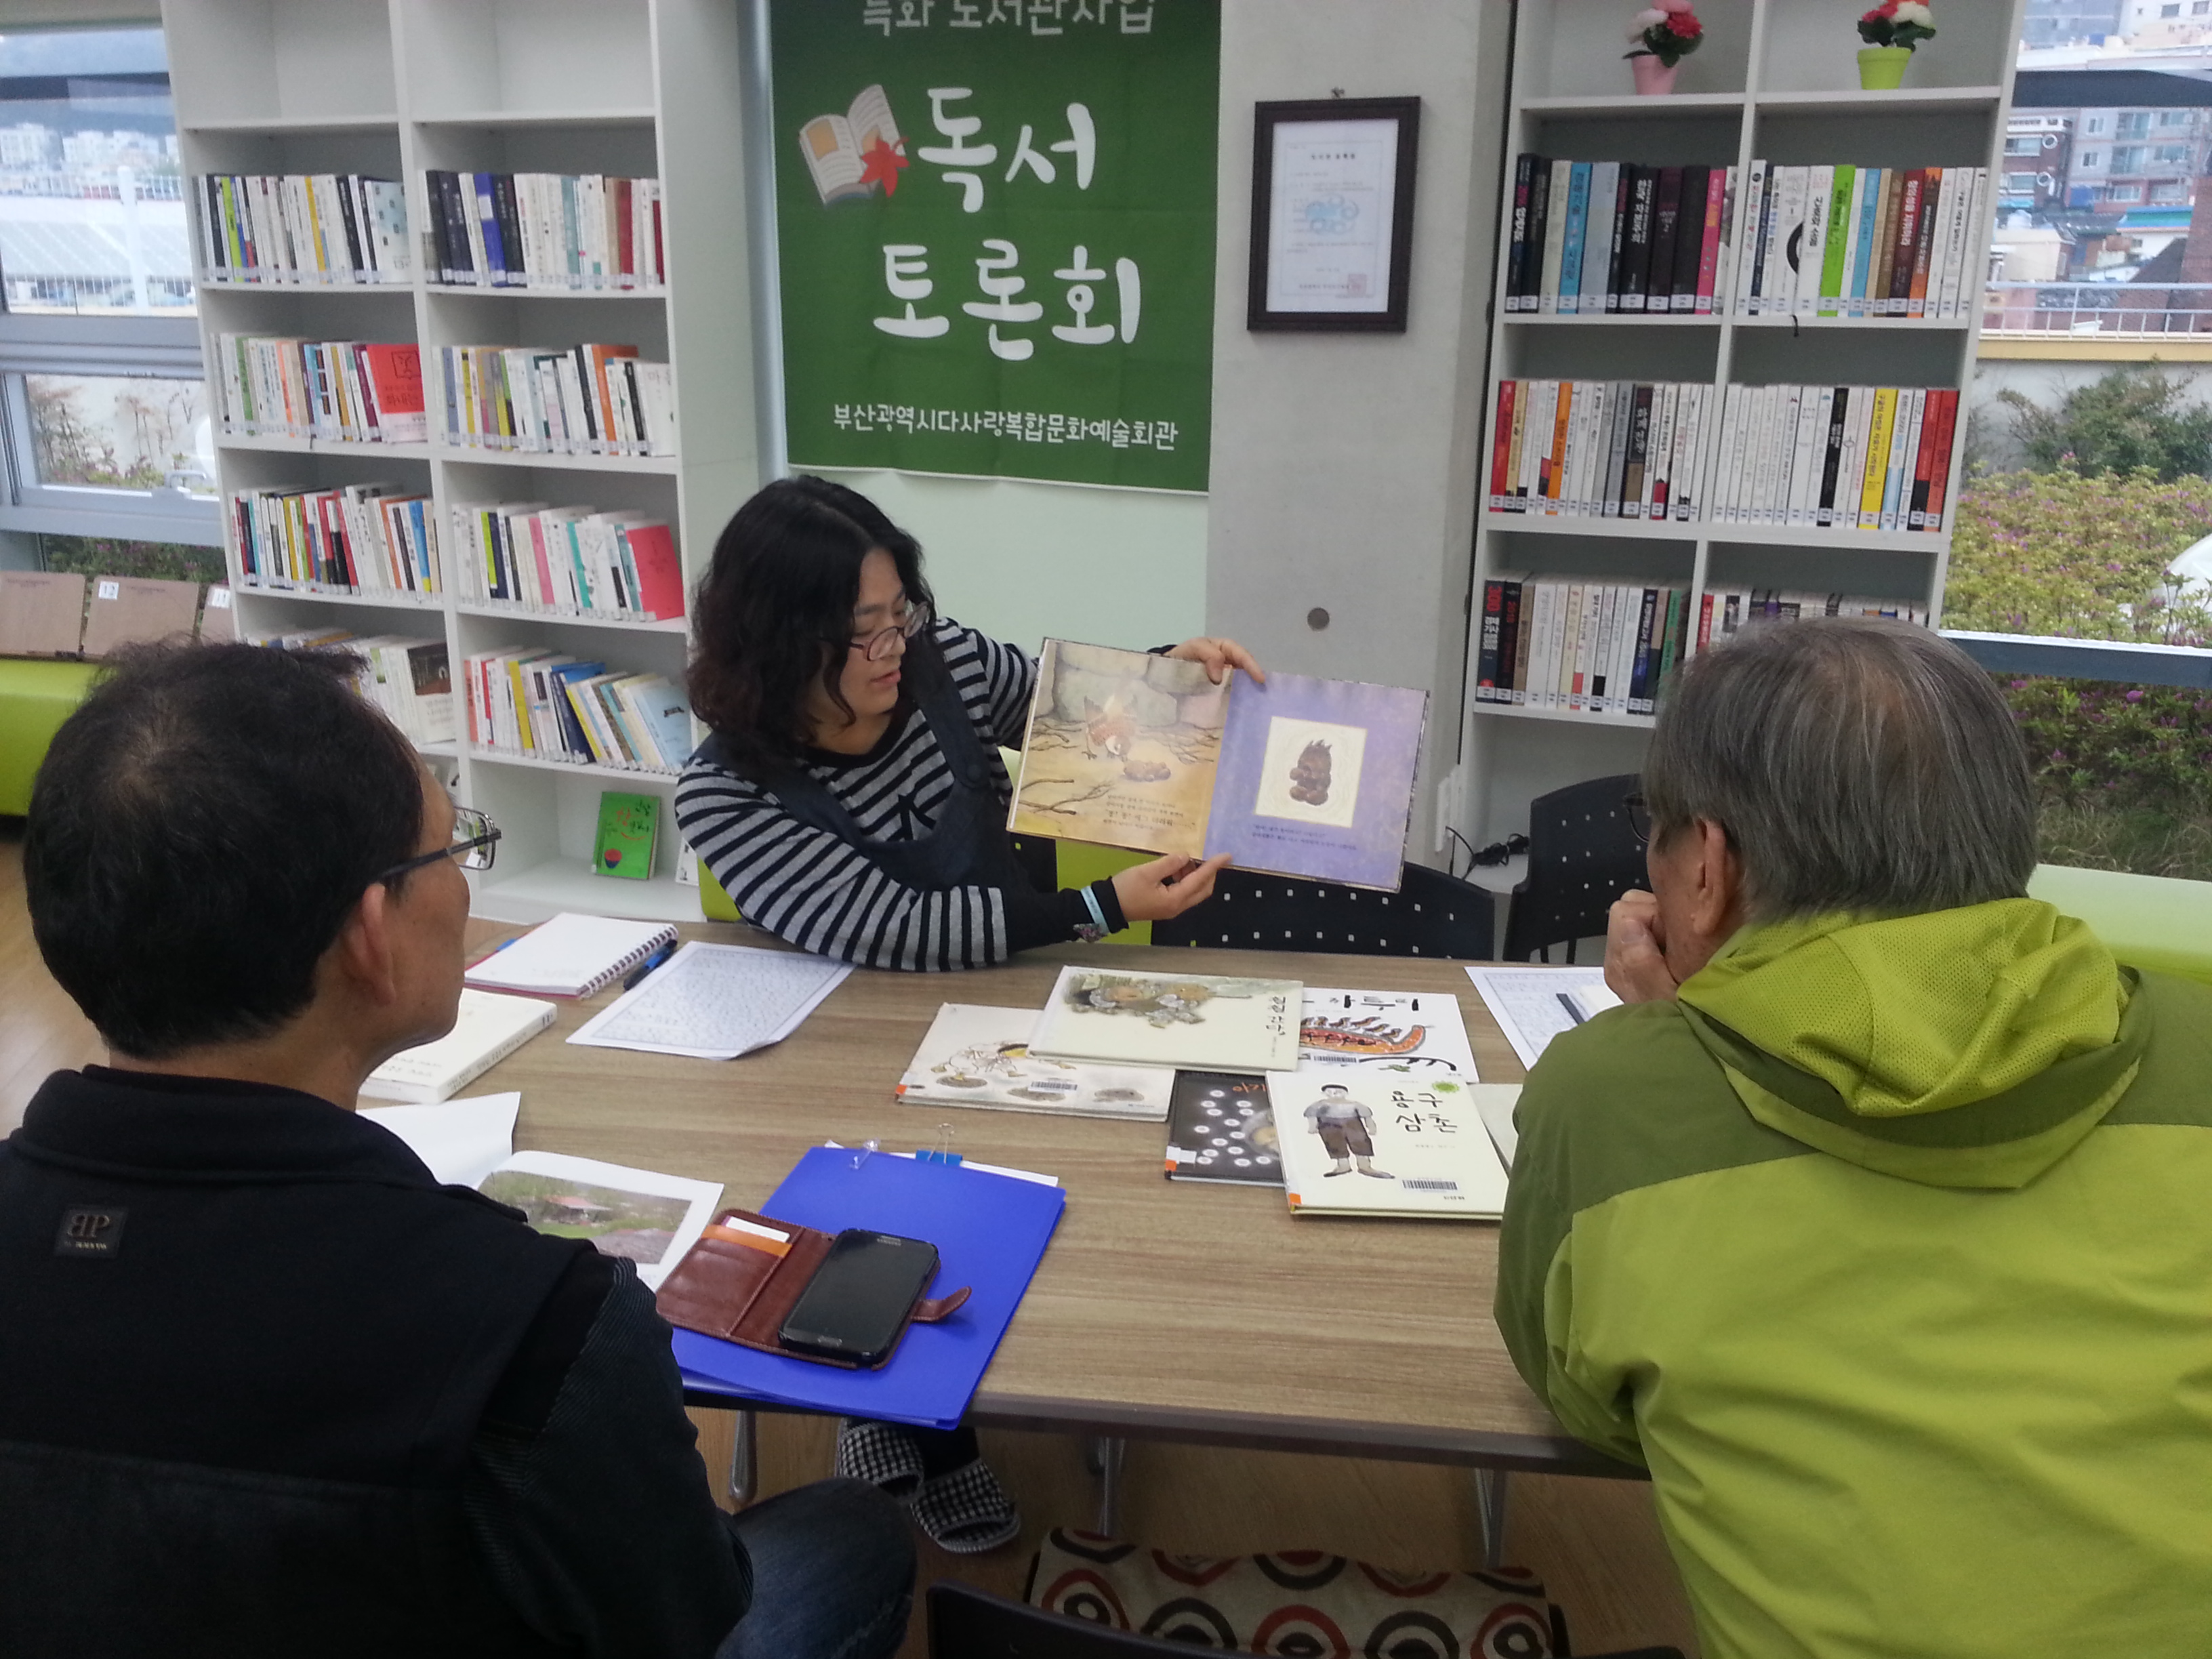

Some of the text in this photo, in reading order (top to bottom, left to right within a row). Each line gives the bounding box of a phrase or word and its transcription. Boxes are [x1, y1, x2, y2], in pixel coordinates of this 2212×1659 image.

[918, 87, 1097, 213] 독서
[873, 239, 1141, 361] 토론회
[834, 403, 1178, 451] 부산광역시다사랑복합문화예술회관
[1391, 1090, 1443, 1109] 용구
[1395, 1113, 1458, 1134] 삼촌
